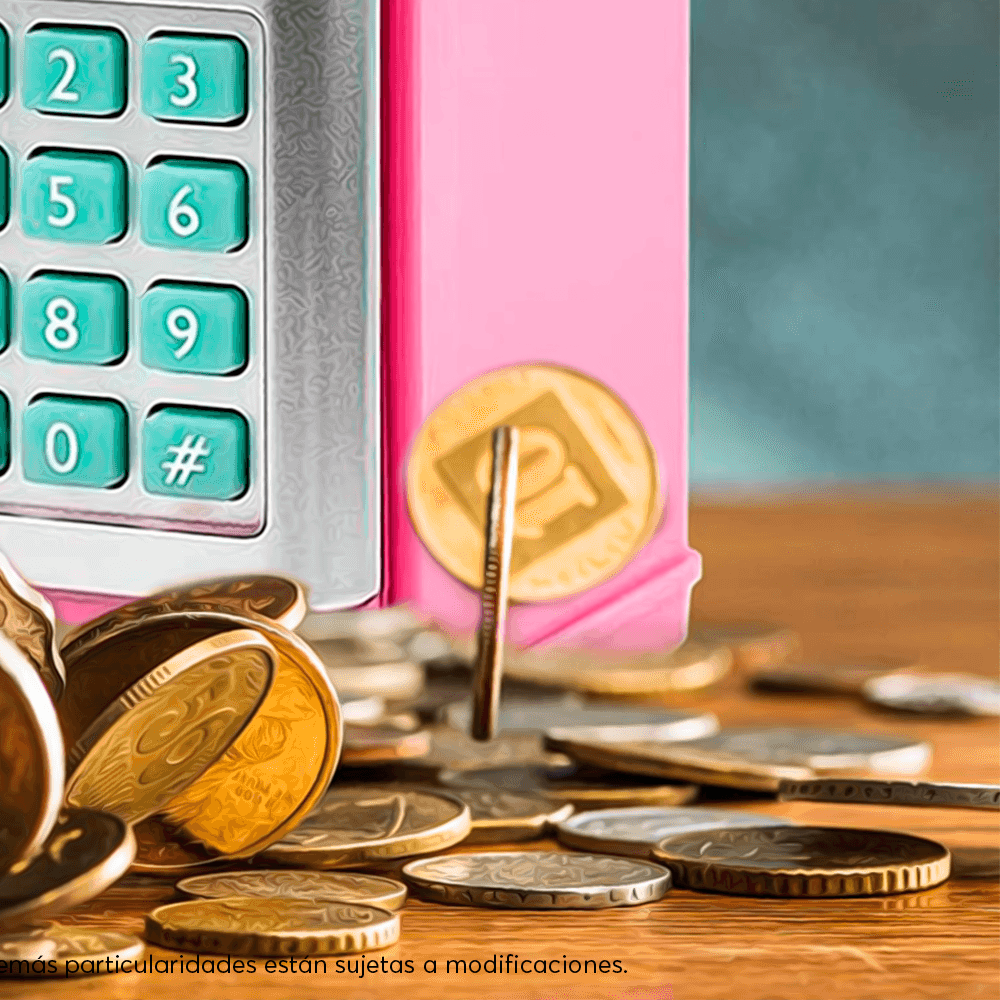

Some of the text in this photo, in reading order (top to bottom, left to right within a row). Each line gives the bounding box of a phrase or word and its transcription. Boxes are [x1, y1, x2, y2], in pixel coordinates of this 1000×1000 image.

[46, 48, 79, 102] 2
[169, 55, 199, 108] 3
[47, 175, 76, 228] 5
[167, 184, 200, 237] 6
[43, 296, 80, 351] 8
[165, 307, 198, 360] 9
[44, 421, 79, 475] 0
[161, 433, 211, 486] #
